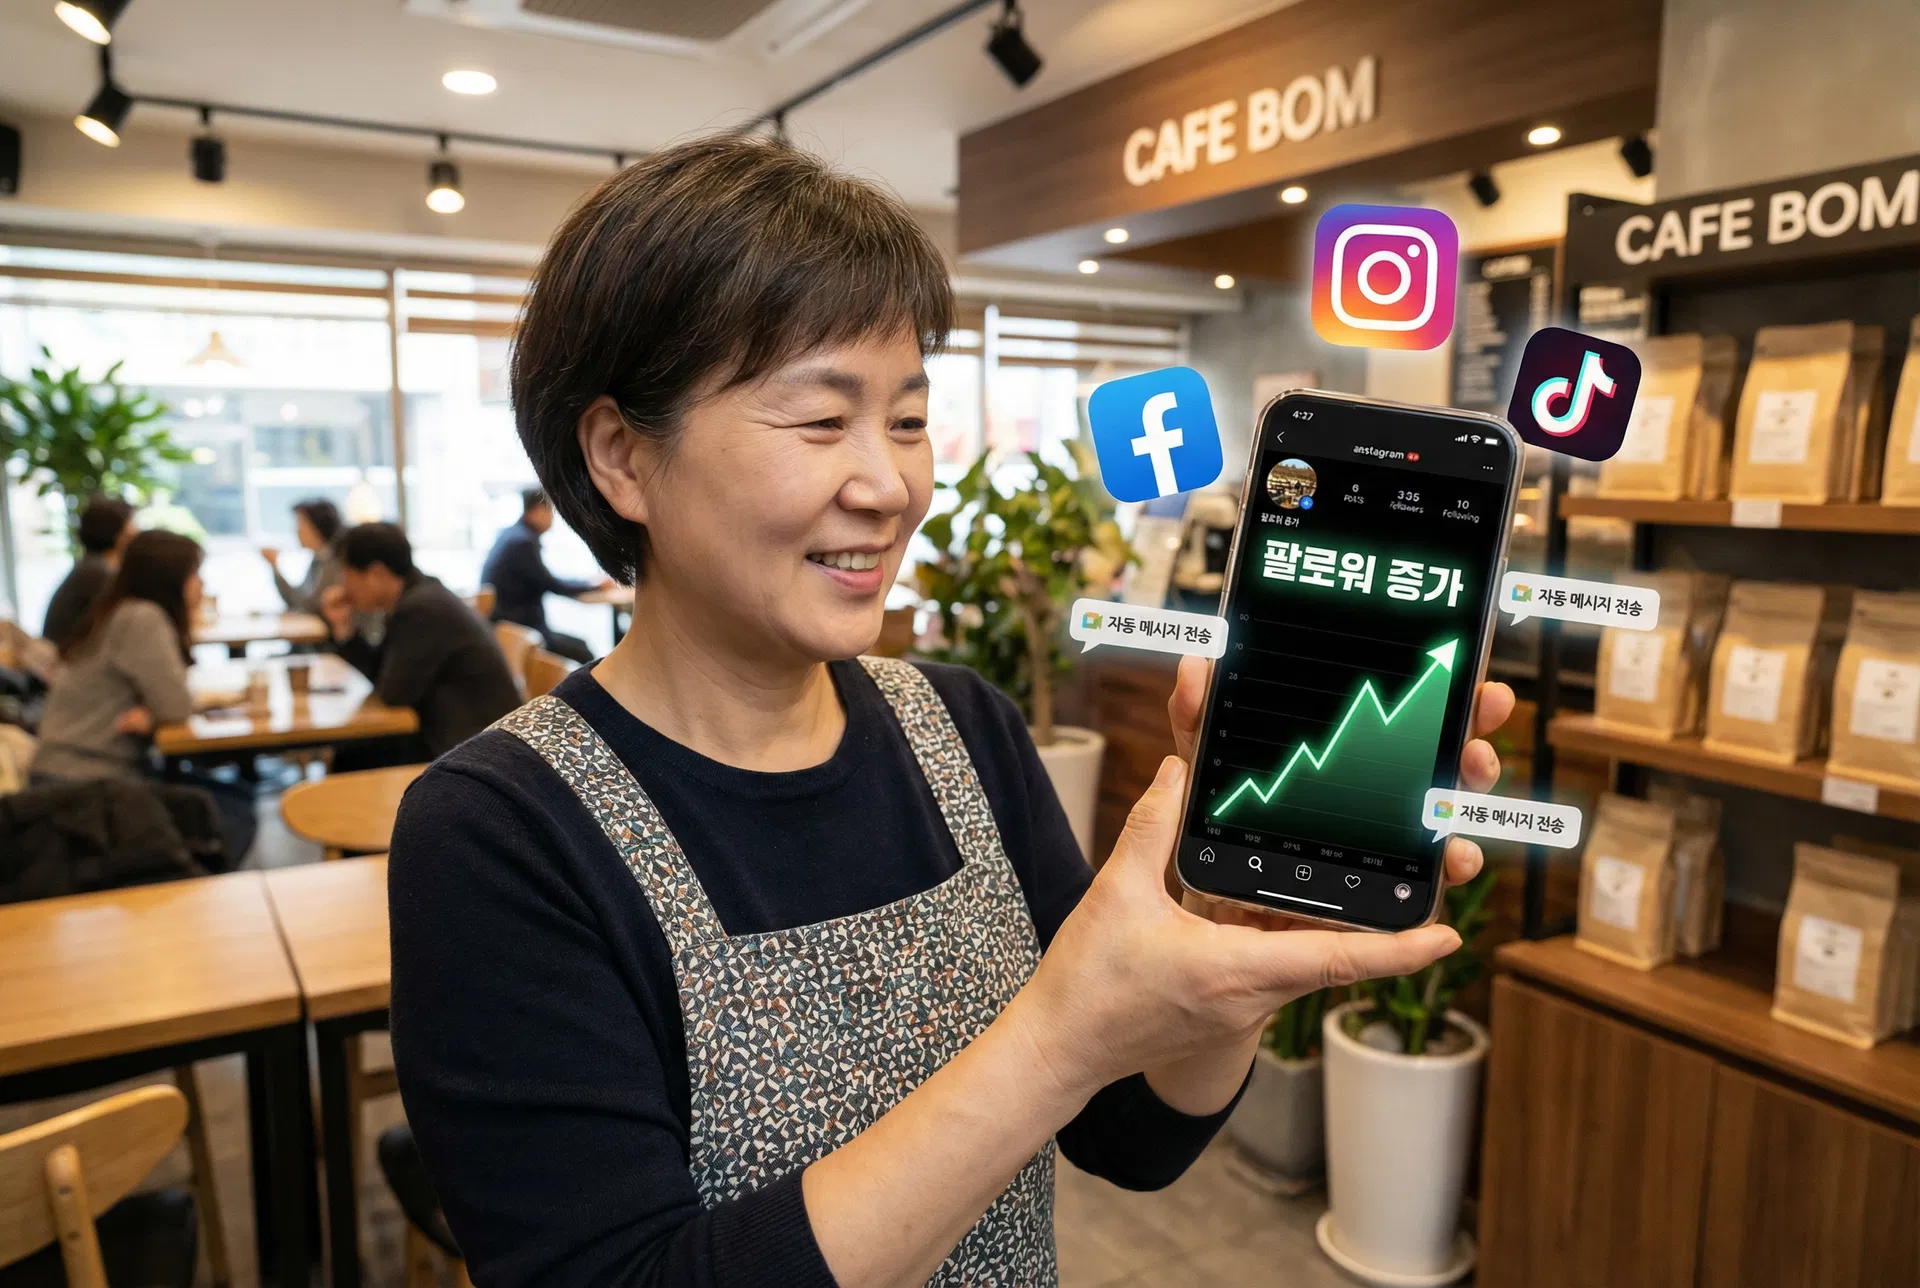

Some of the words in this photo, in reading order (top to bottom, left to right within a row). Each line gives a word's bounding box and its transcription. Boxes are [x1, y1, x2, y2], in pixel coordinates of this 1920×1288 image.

[1123, 99, 1238, 186] CAFE
[1247, 55, 1375, 153] BOM
[1615, 198, 1755, 265] CAFE
[1767, 170, 1919, 245] BOM
[1352, 484, 1359, 492] 6
[1457, 500, 1470, 510] 10
[1262, 539, 1376, 594] 팔로워
[1386, 559, 1464, 608] 증가
